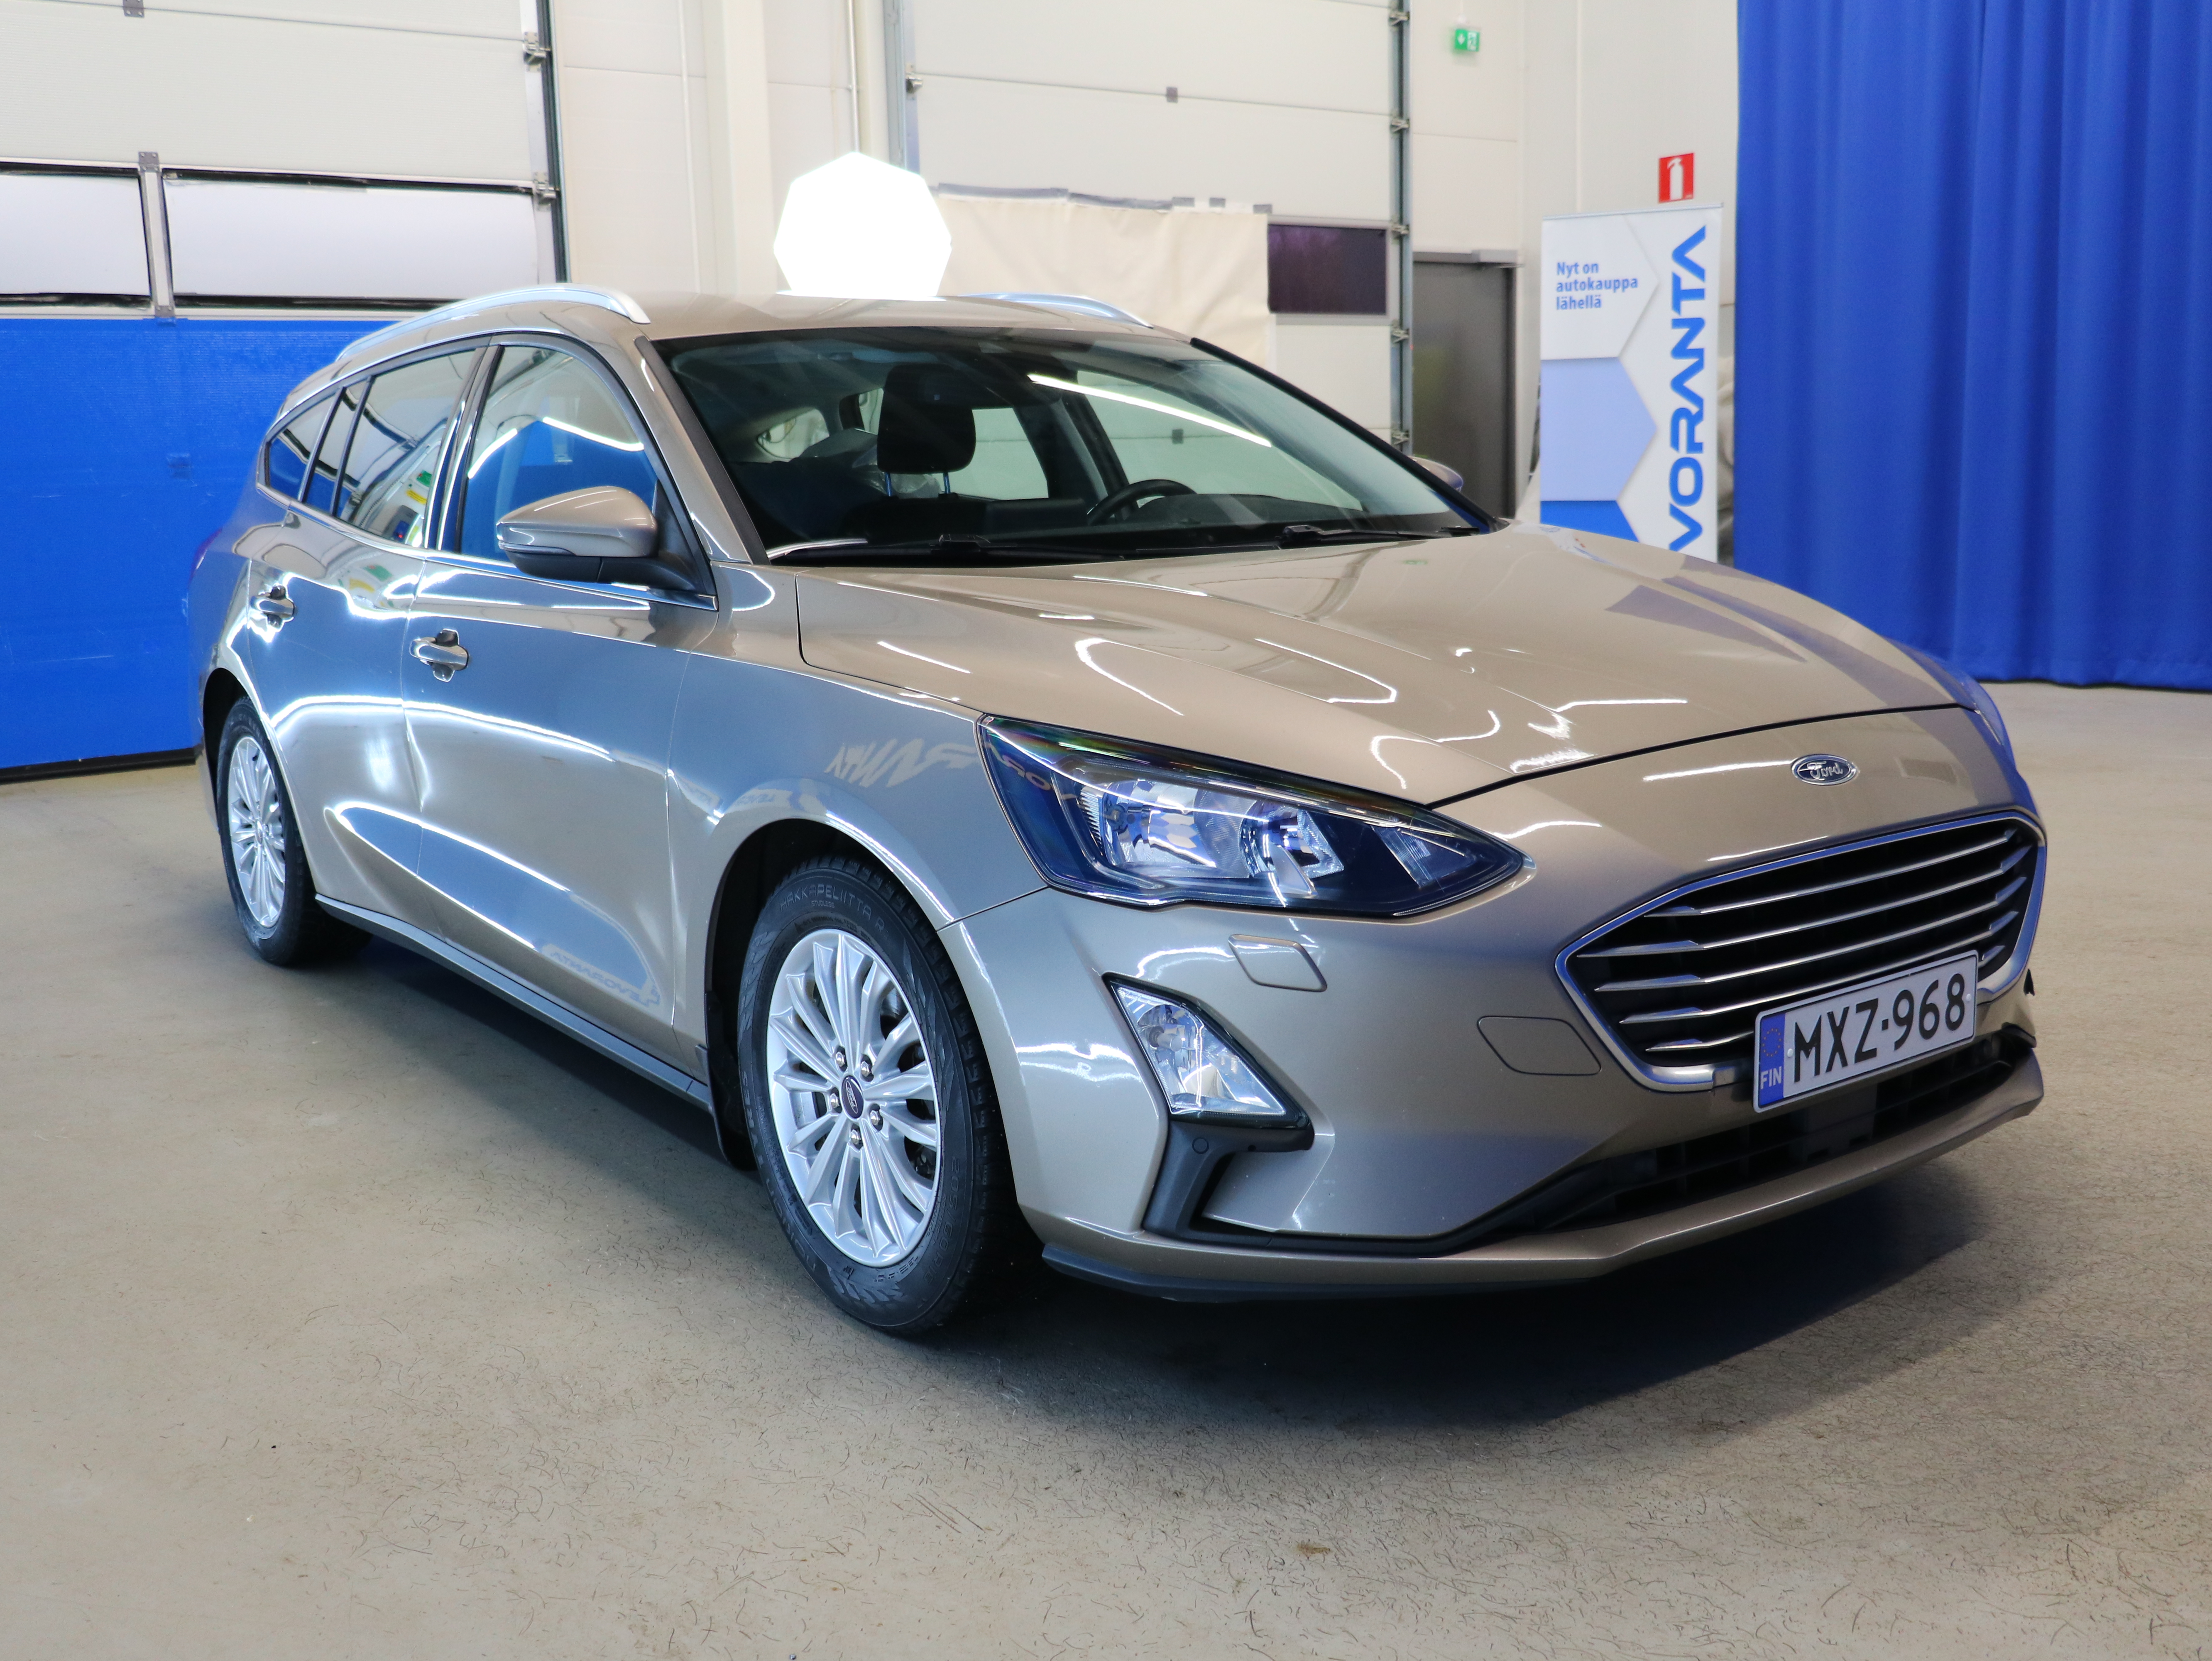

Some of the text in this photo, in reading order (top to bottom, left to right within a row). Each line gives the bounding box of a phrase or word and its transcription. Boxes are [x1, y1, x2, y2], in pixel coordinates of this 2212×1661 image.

[1557, 262, 1599, 279] Nyt on
[1556, 277, 1638, 293] autokauppa
[1556, 294, 1602, 310] lähellä
[1807, 761, 1843, 781] Ford
[779, 883, 872, 921] HAKKAPELIITTA
[1794, 973, 1966, 1083] MXZ-968
[1760, 1066, 1782, 1090] FIN
